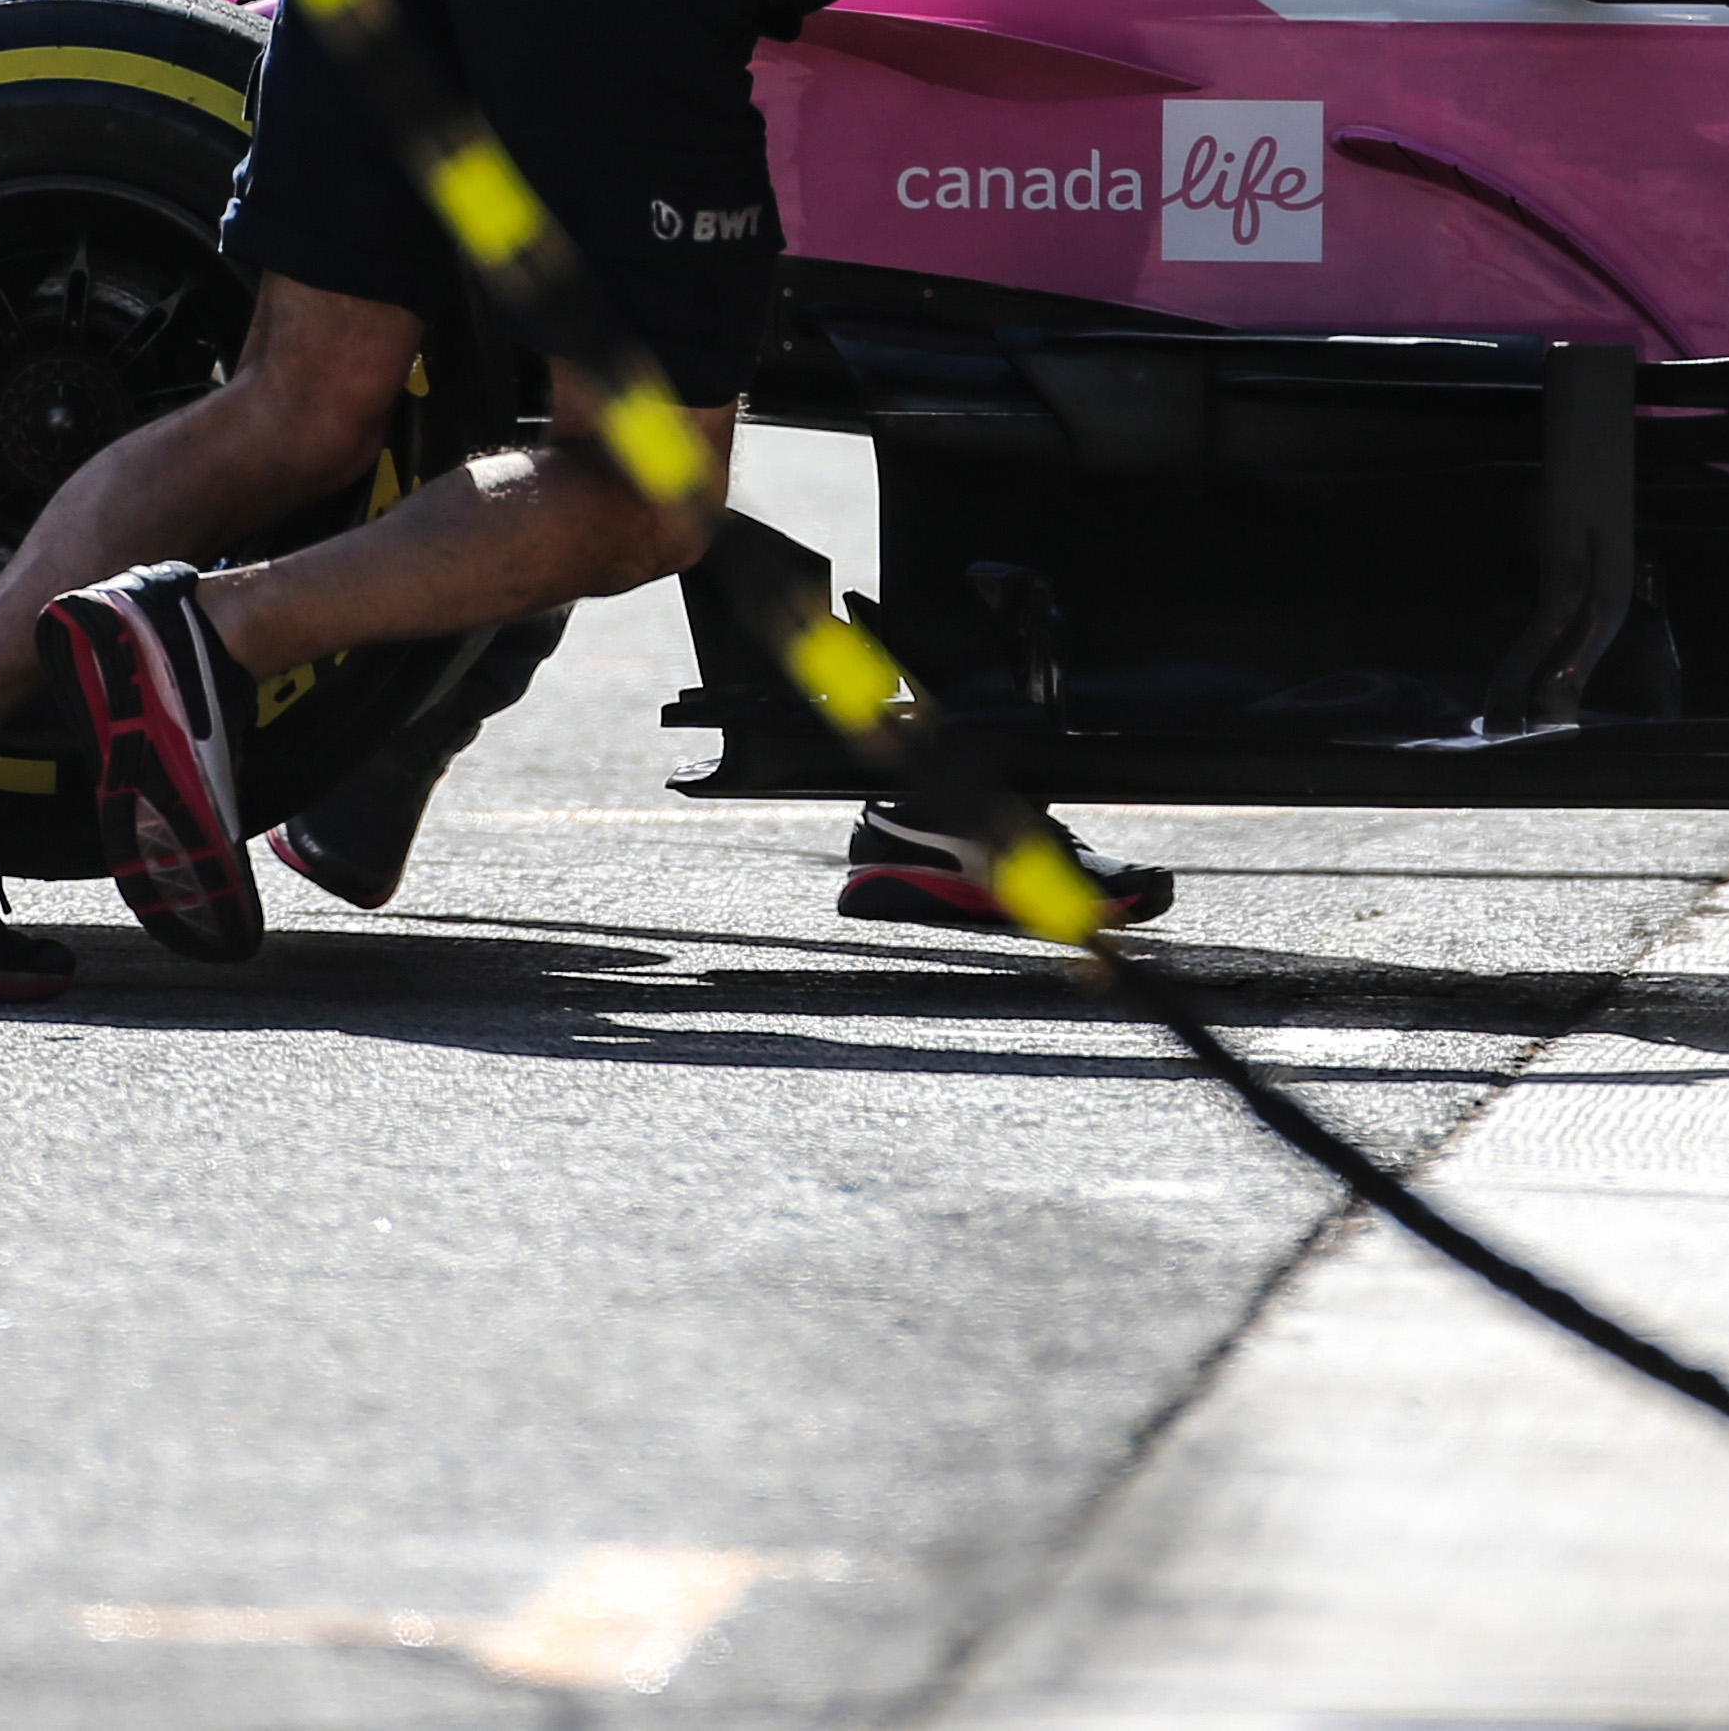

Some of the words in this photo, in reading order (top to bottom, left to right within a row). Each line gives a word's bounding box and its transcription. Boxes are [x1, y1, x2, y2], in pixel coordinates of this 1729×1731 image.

[693, 204, 762, 243] BWT
[895, 148, 1143, 212] canada
[1161, 133, 1324, 246] life
